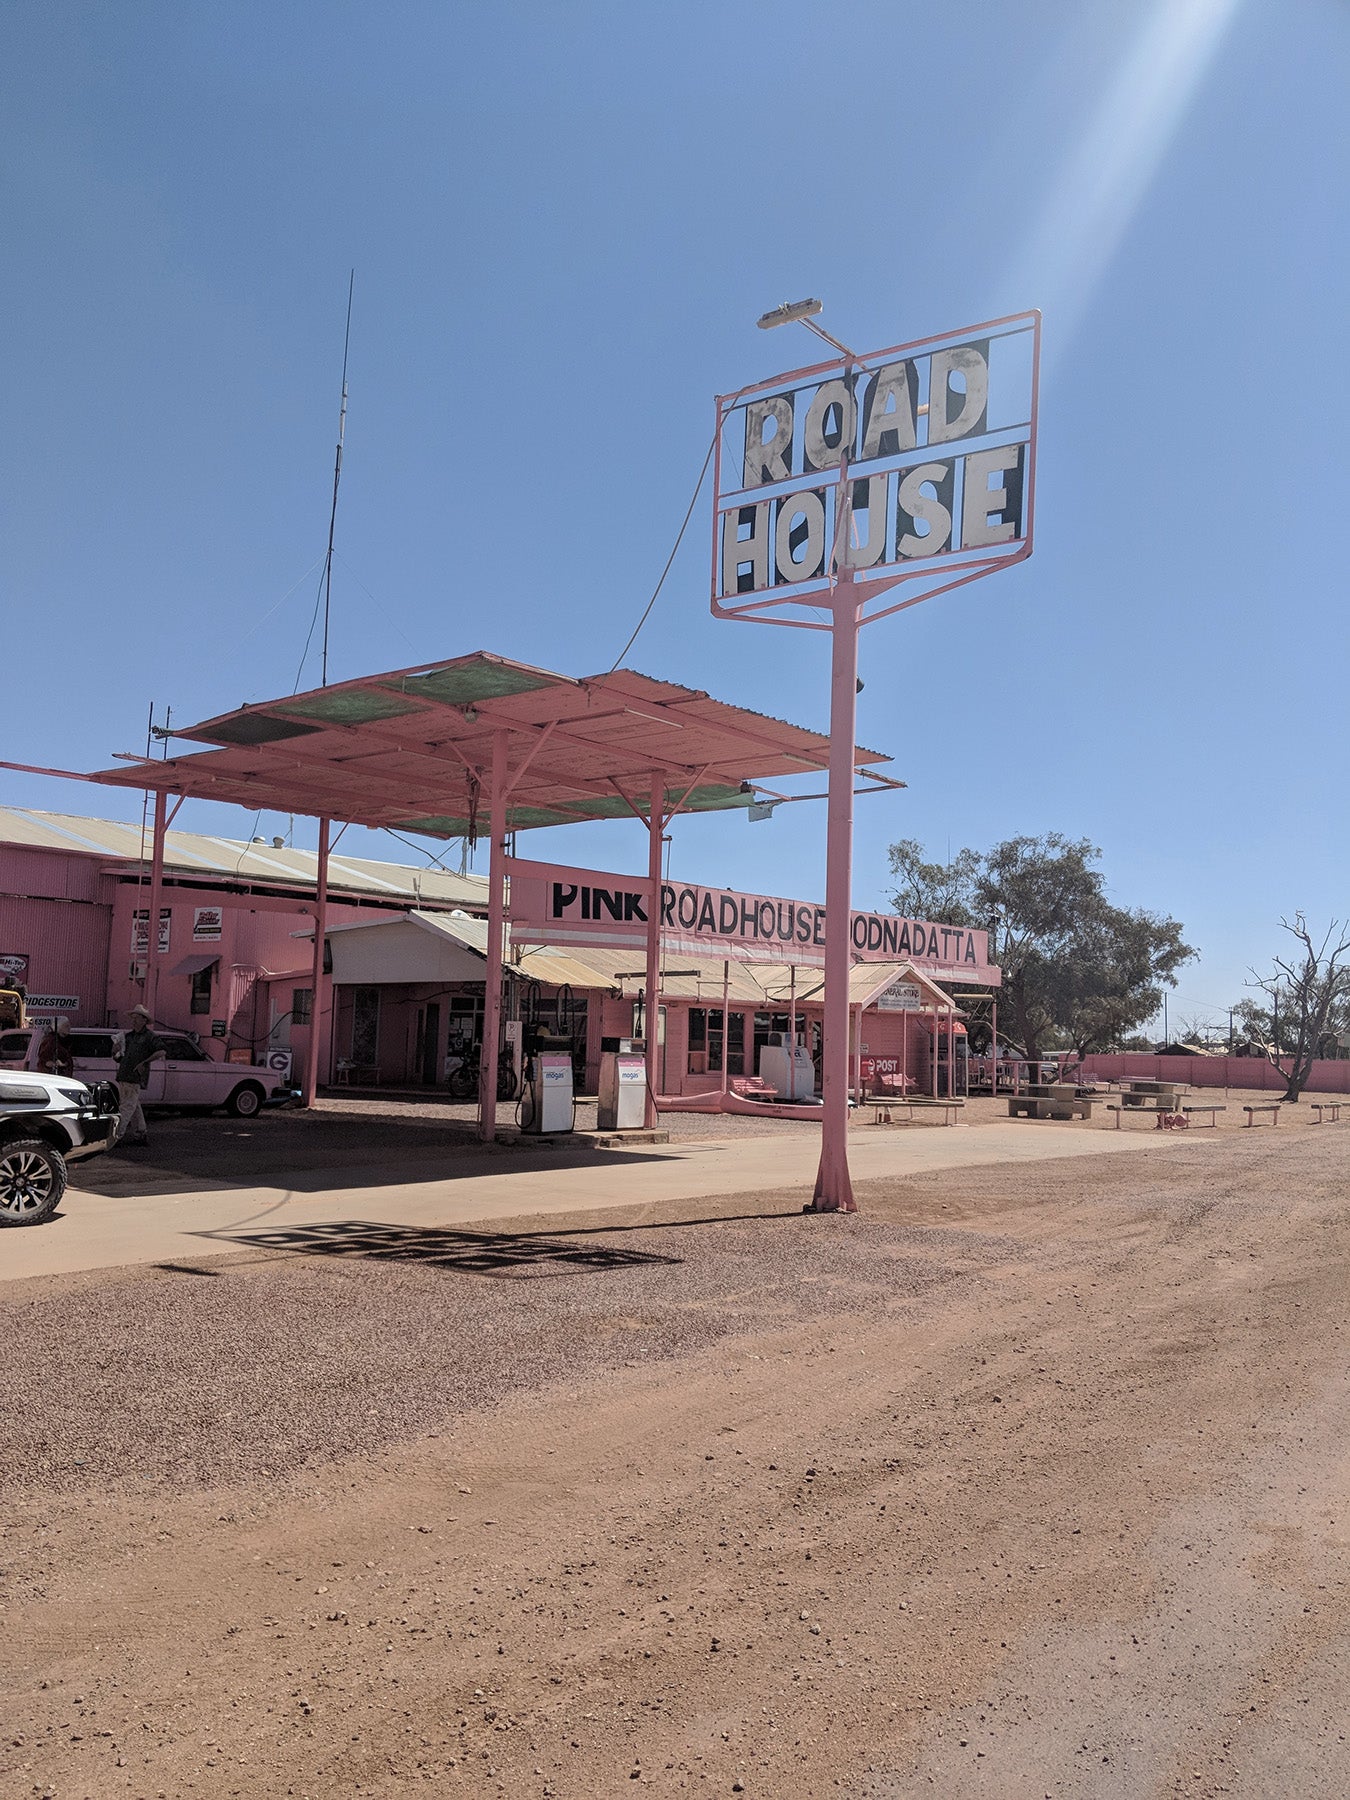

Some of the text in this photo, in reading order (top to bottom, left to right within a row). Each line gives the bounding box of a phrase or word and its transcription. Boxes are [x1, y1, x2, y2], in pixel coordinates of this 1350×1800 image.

[744, 347, 988, 488] ROAD
[722, 445, 1019, 595] HOUSE
[552, 882, 976, 964] PINK ROADHOUSE ODNADATTA
[24, 996, 78, 1007] RIDGESTONE
[876, 1059, 898, 1072] POST
[545, 1071, 564, 1081] mogas
[621, 1071, 639, 1080] mogas
